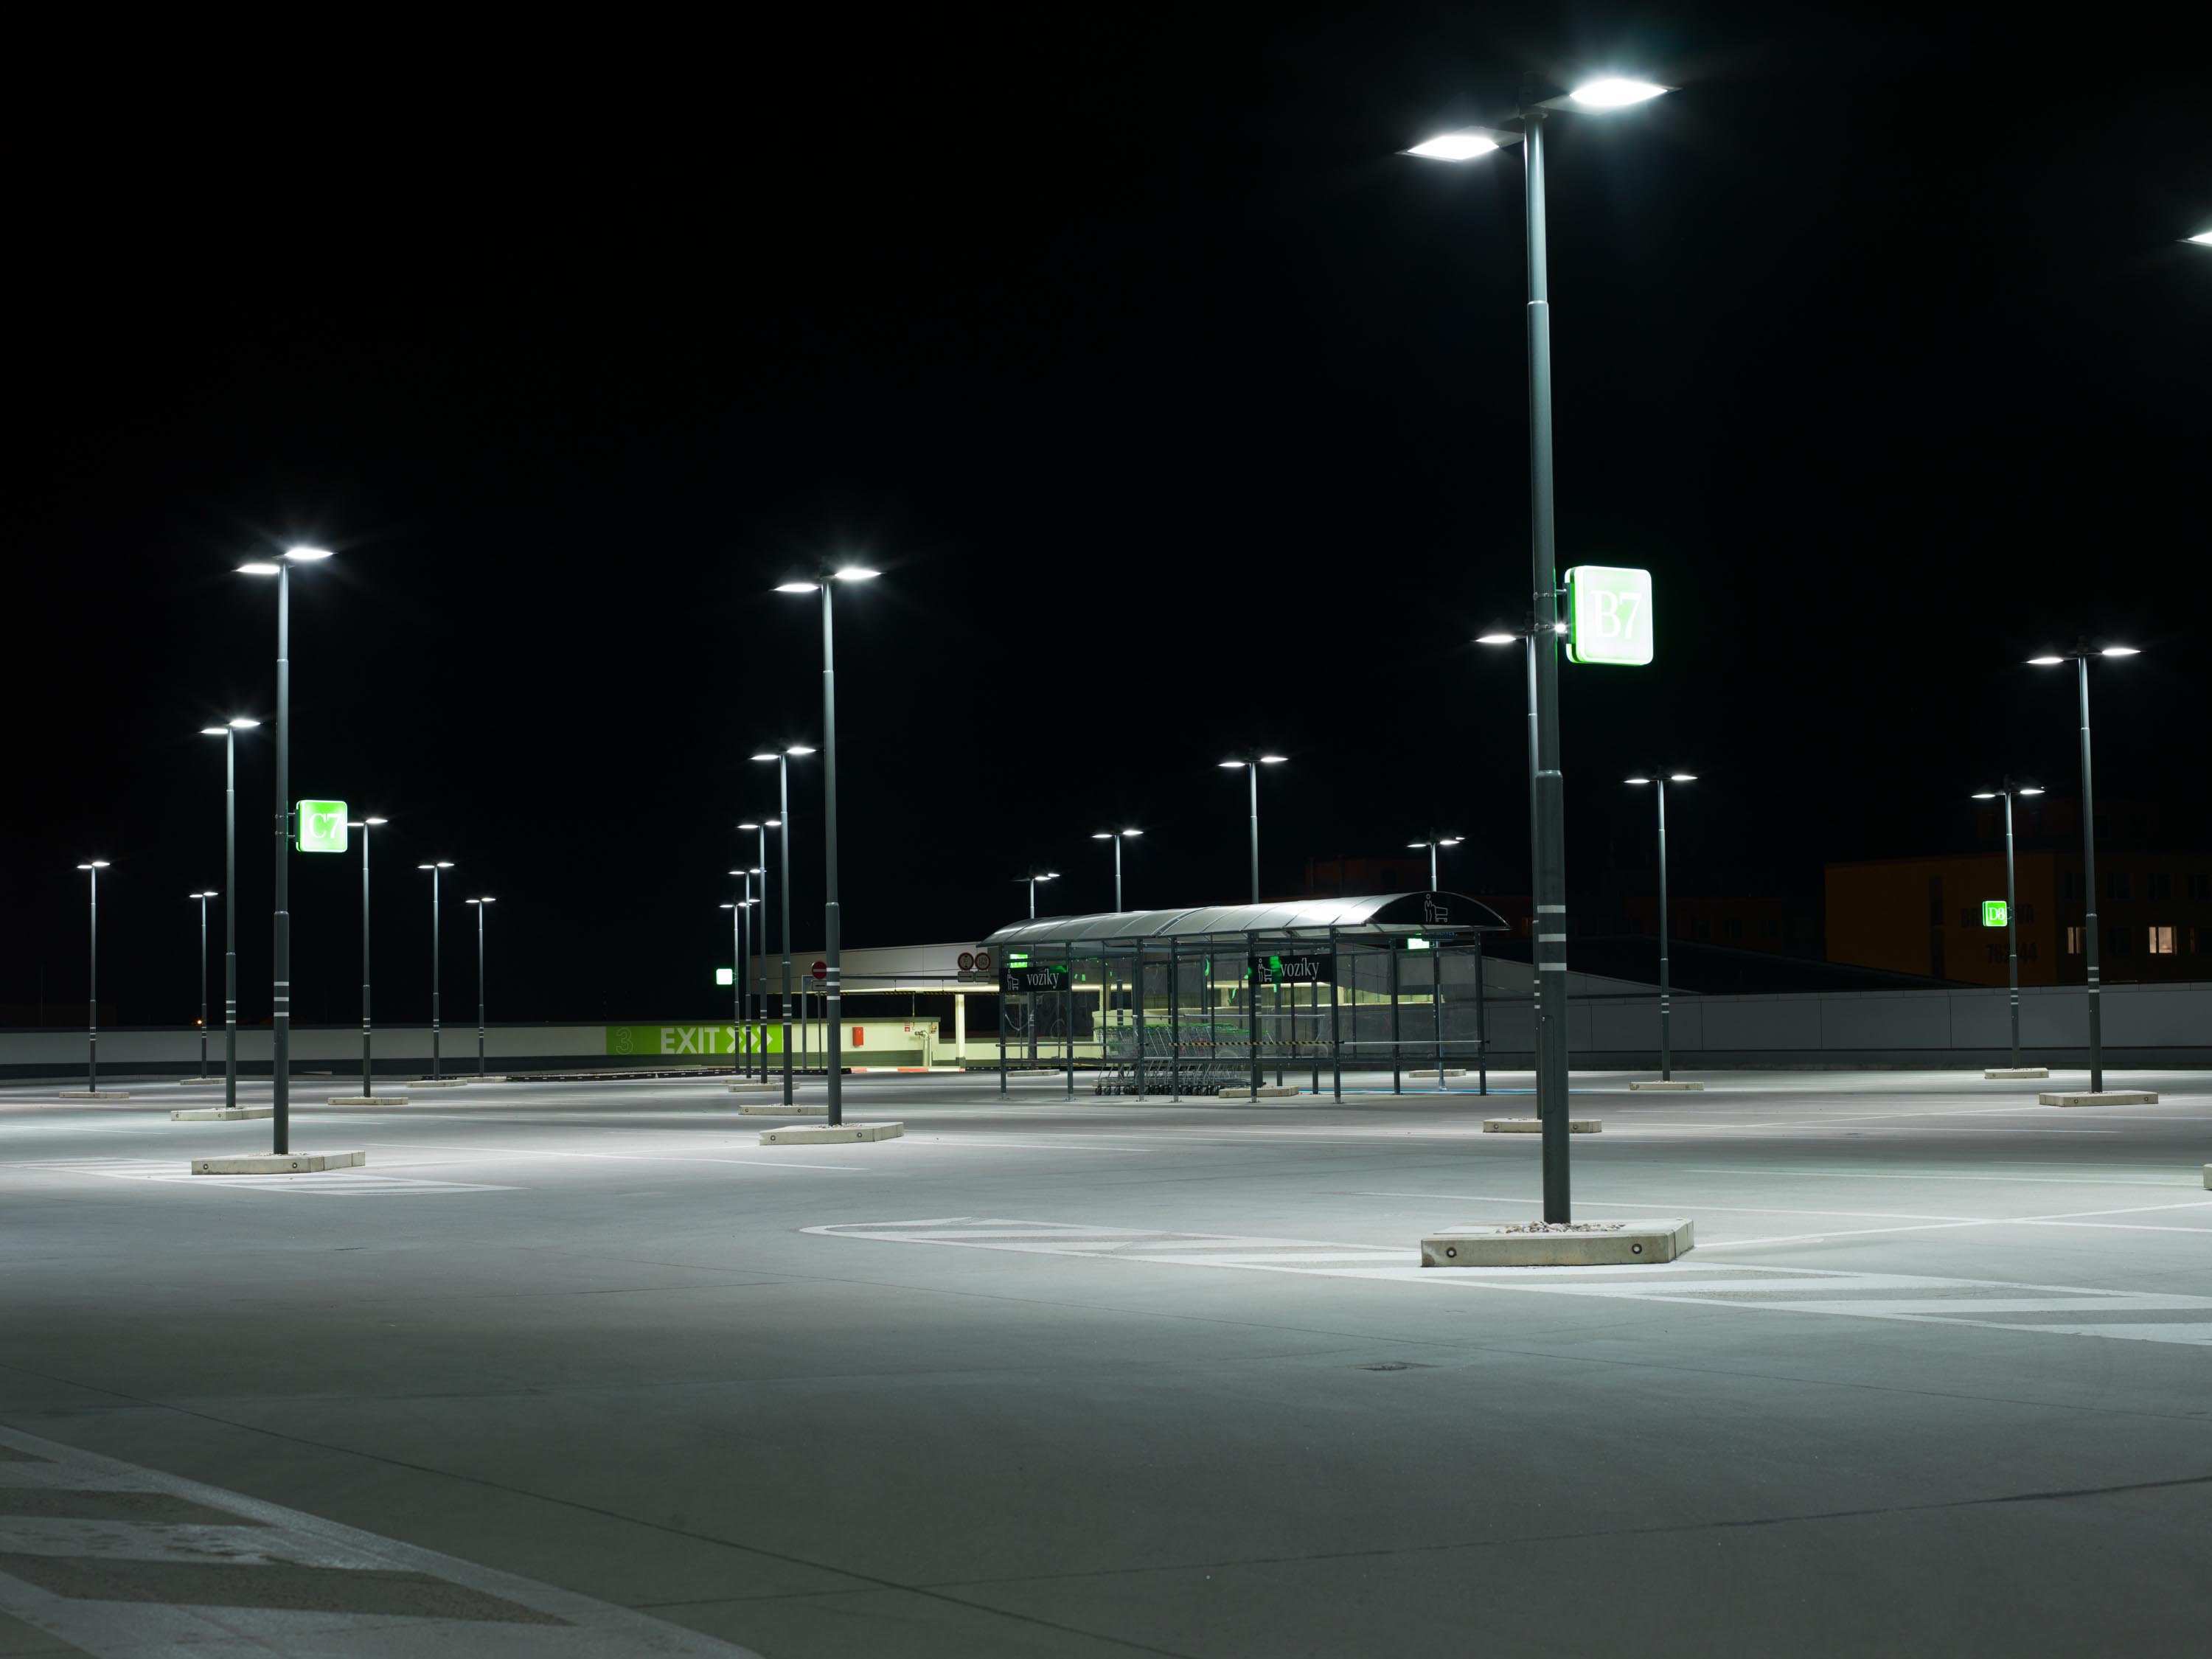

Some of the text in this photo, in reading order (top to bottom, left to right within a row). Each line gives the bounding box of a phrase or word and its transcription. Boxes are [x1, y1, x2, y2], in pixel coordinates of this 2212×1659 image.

[1590, 589, 1642, 639] B7
[309, 813, 341, 839] C7
[1989, 907, 2005, 921] D8
[1026, 967, 1059, 989] vozíky
[1280, 957, 1320, 980] vozíky
[615, 1026, 720, 1055] 3 EXIT
